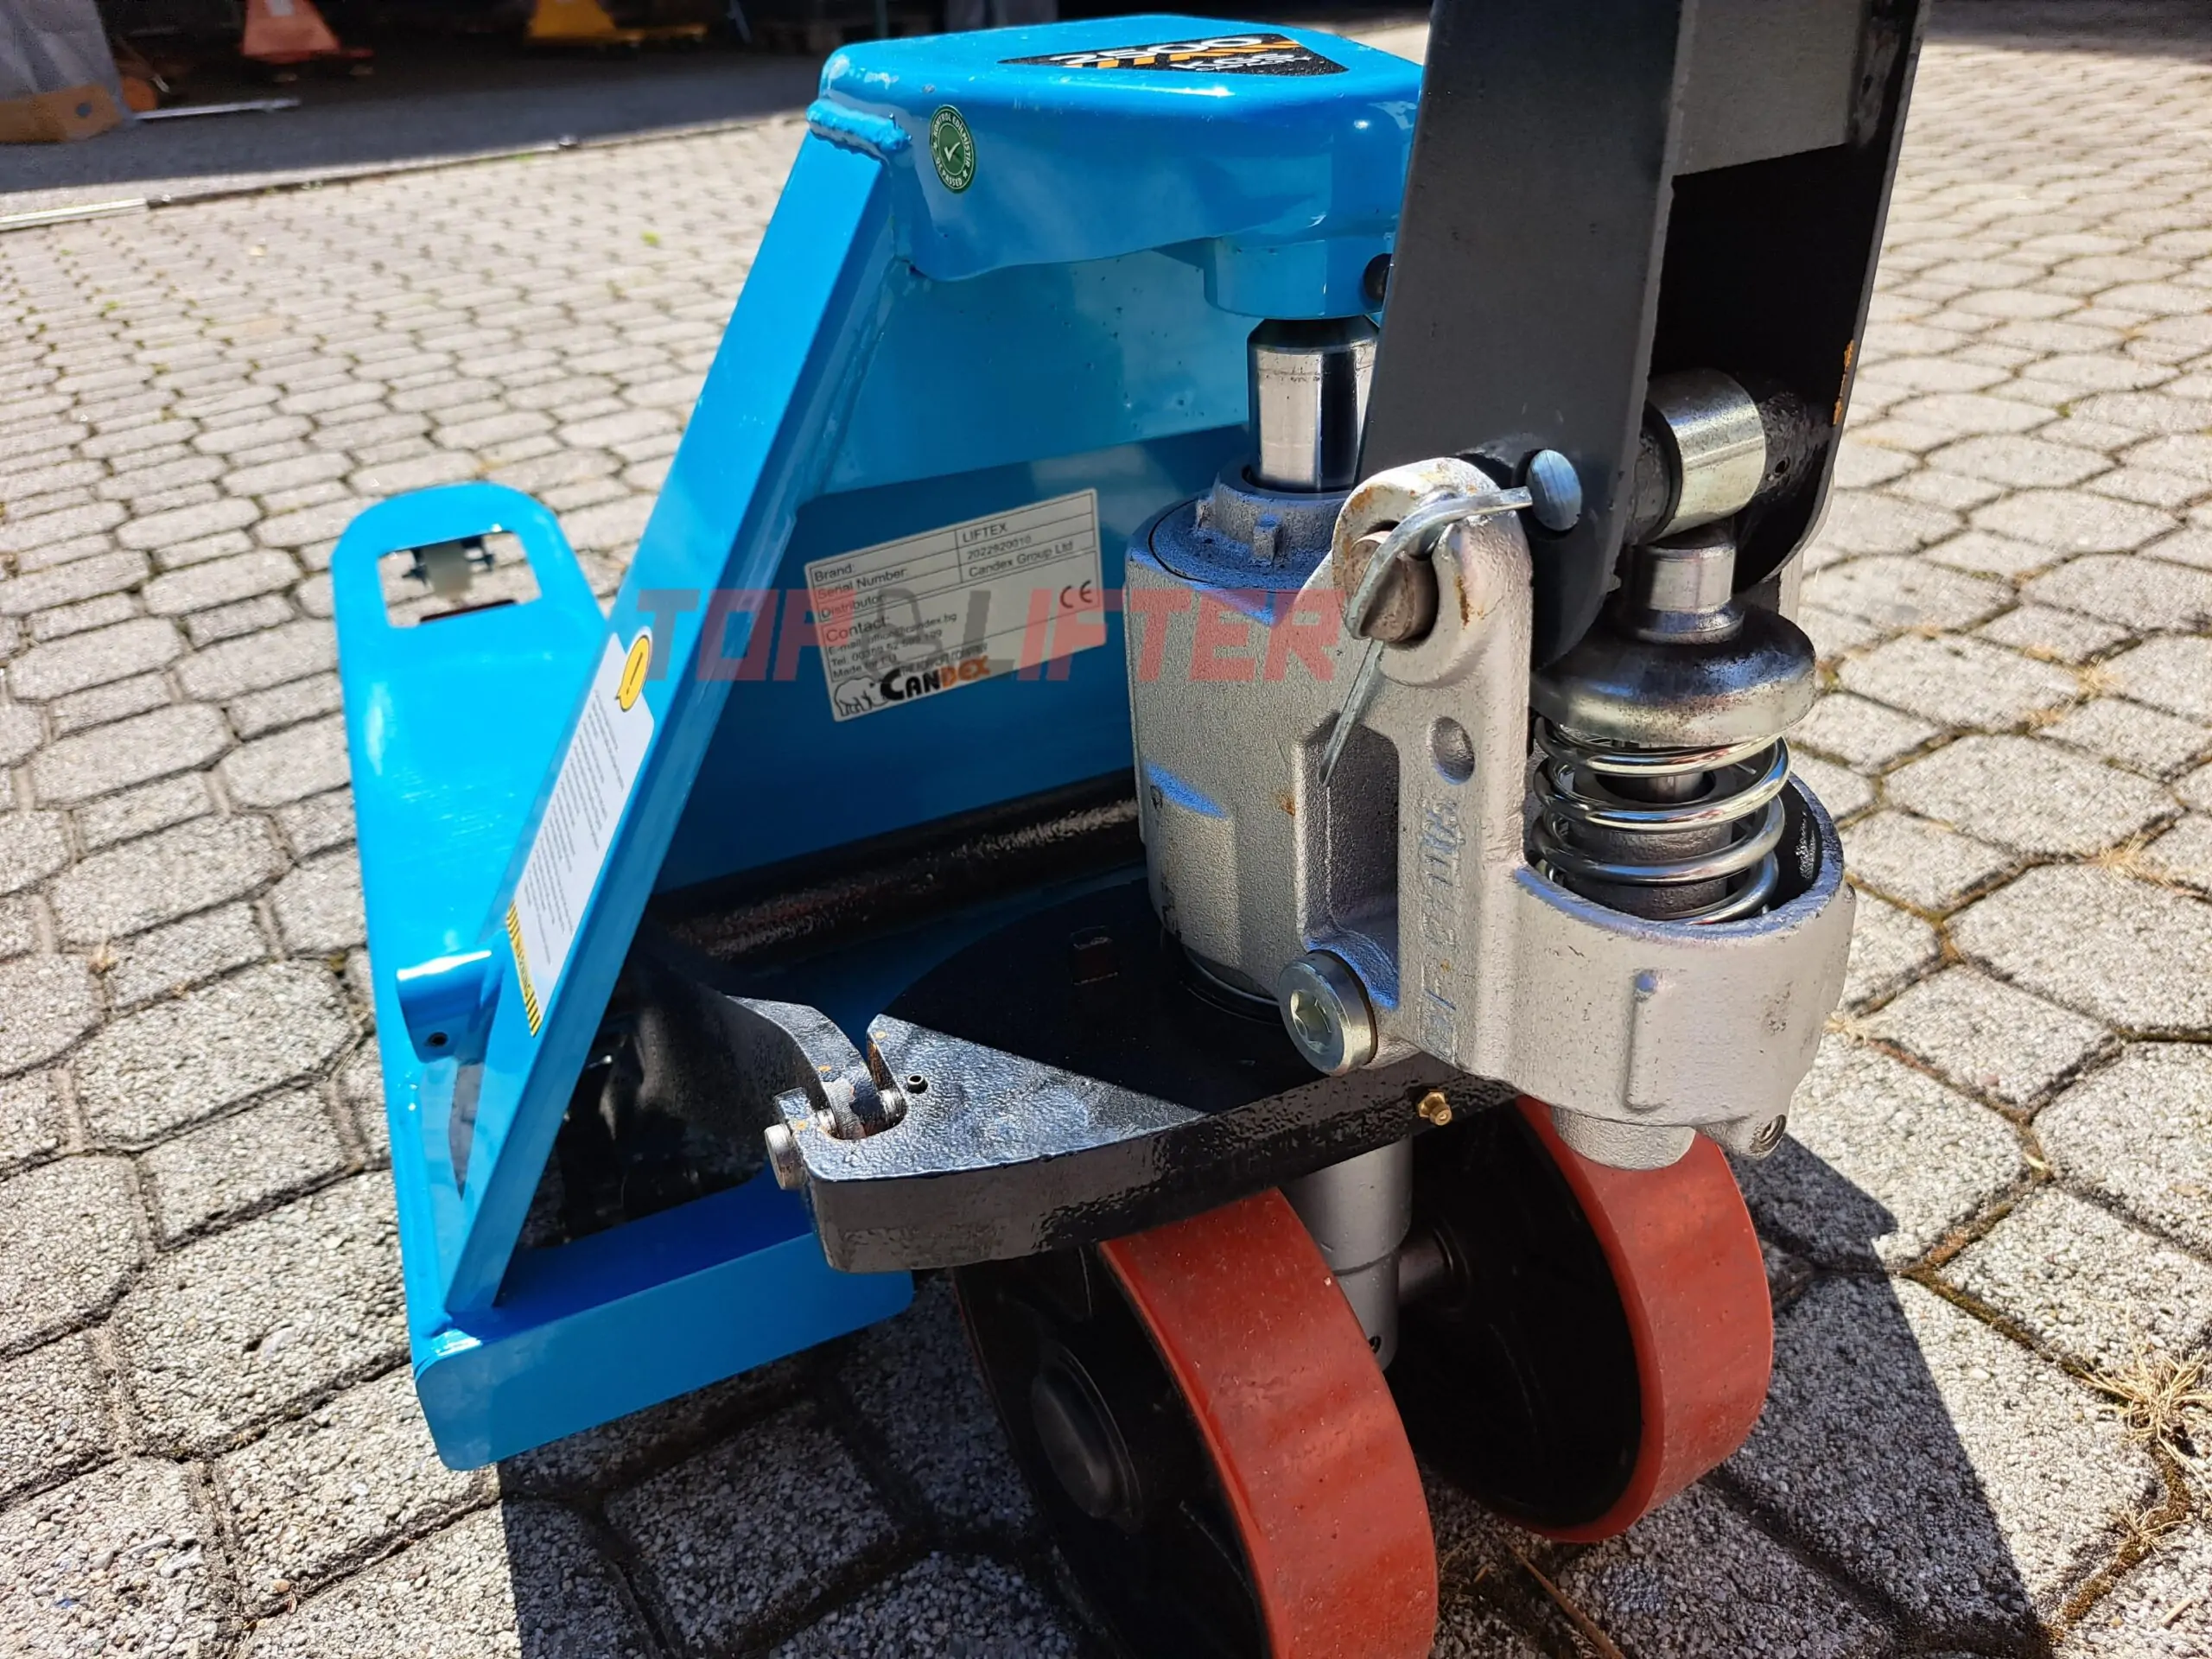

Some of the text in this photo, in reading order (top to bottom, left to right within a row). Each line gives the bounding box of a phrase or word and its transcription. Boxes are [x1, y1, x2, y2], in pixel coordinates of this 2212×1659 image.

[1049, 38, 1262, 65] 2500
[1169, 54, 1294, 69] KGS
[932, 112, 952, 137] KONTROL
[942, 169, 963, 187] PASSED
[963, 523, 1007, 543] LIFTEX
[969, 559, 1014, 577] Candex
[1016, 549, 1053, 564] Group
[1054, 540, 1074, 554] Ltd
[817, 582, 854, 600] Serial
[1060, 580, 1094, 608] CE
[832, 664, 863, 678] Made
[880, 655, 992, 701] CANDEX
